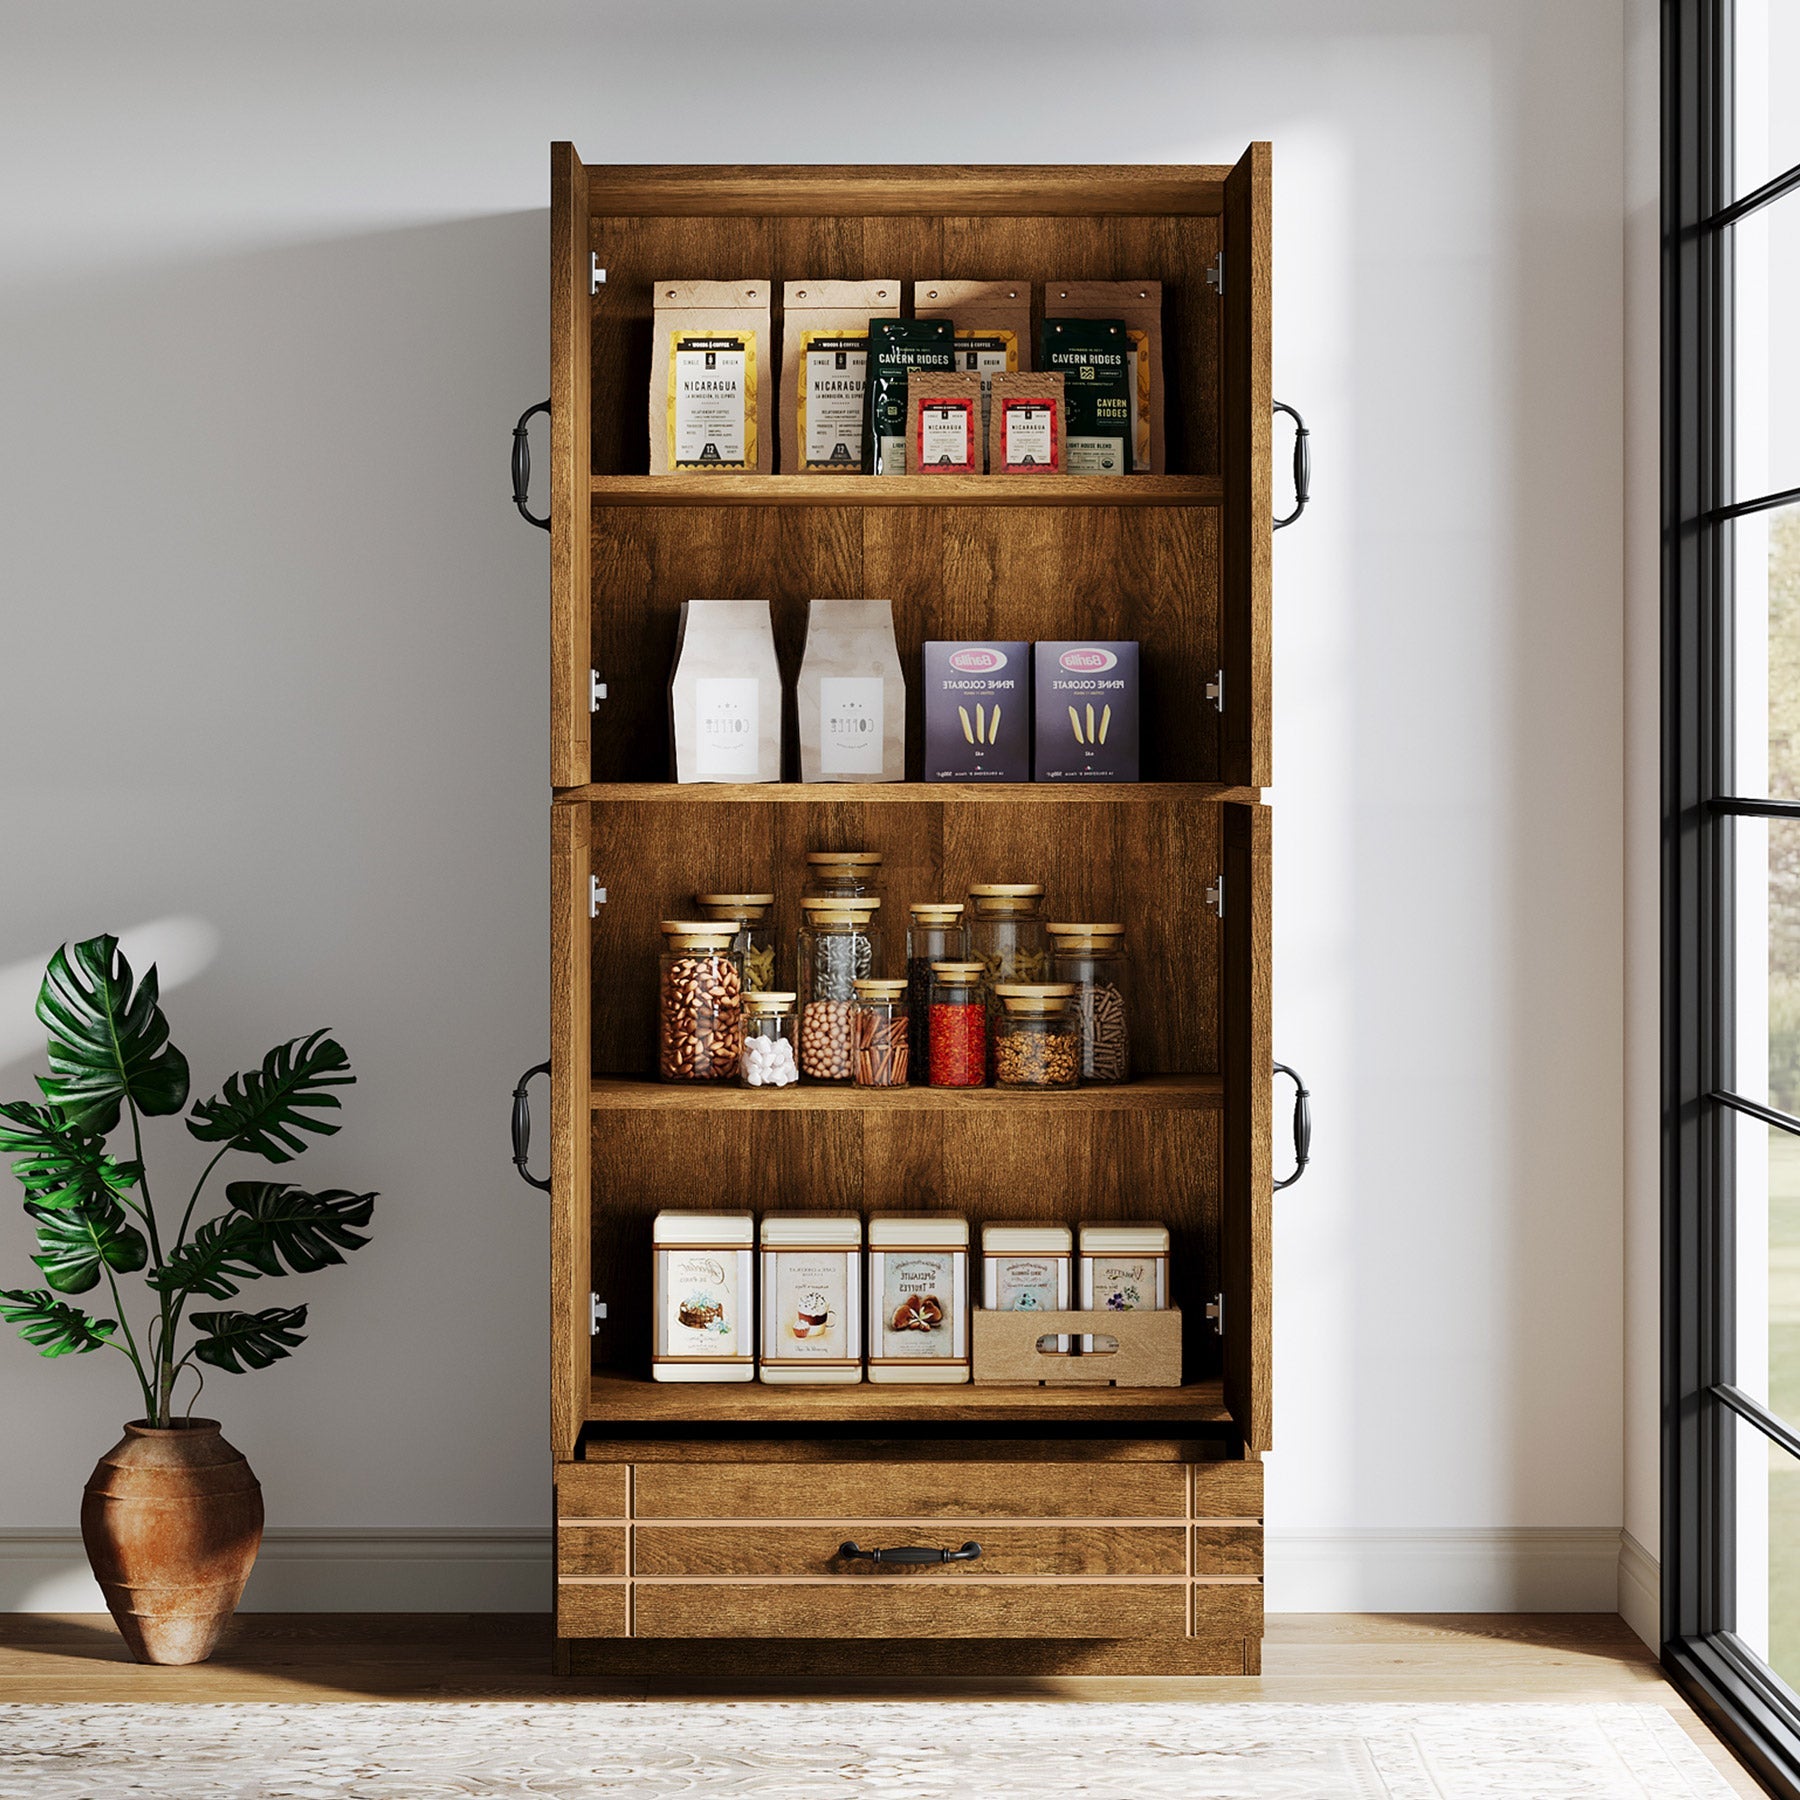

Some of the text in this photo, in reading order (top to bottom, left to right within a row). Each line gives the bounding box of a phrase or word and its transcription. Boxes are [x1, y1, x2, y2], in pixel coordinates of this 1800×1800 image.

[878, 353, 914, 364] CAVERN
[916, 354, 950, 365] RIDGES
[1051, 353, 1122, 365] CAVERN RIDGES
[683, 380, 737, 391] NICARAGUA
[1096, 398, 1127, 407] CAVERN
[1096, 408, 1128, 418] RIDGES
